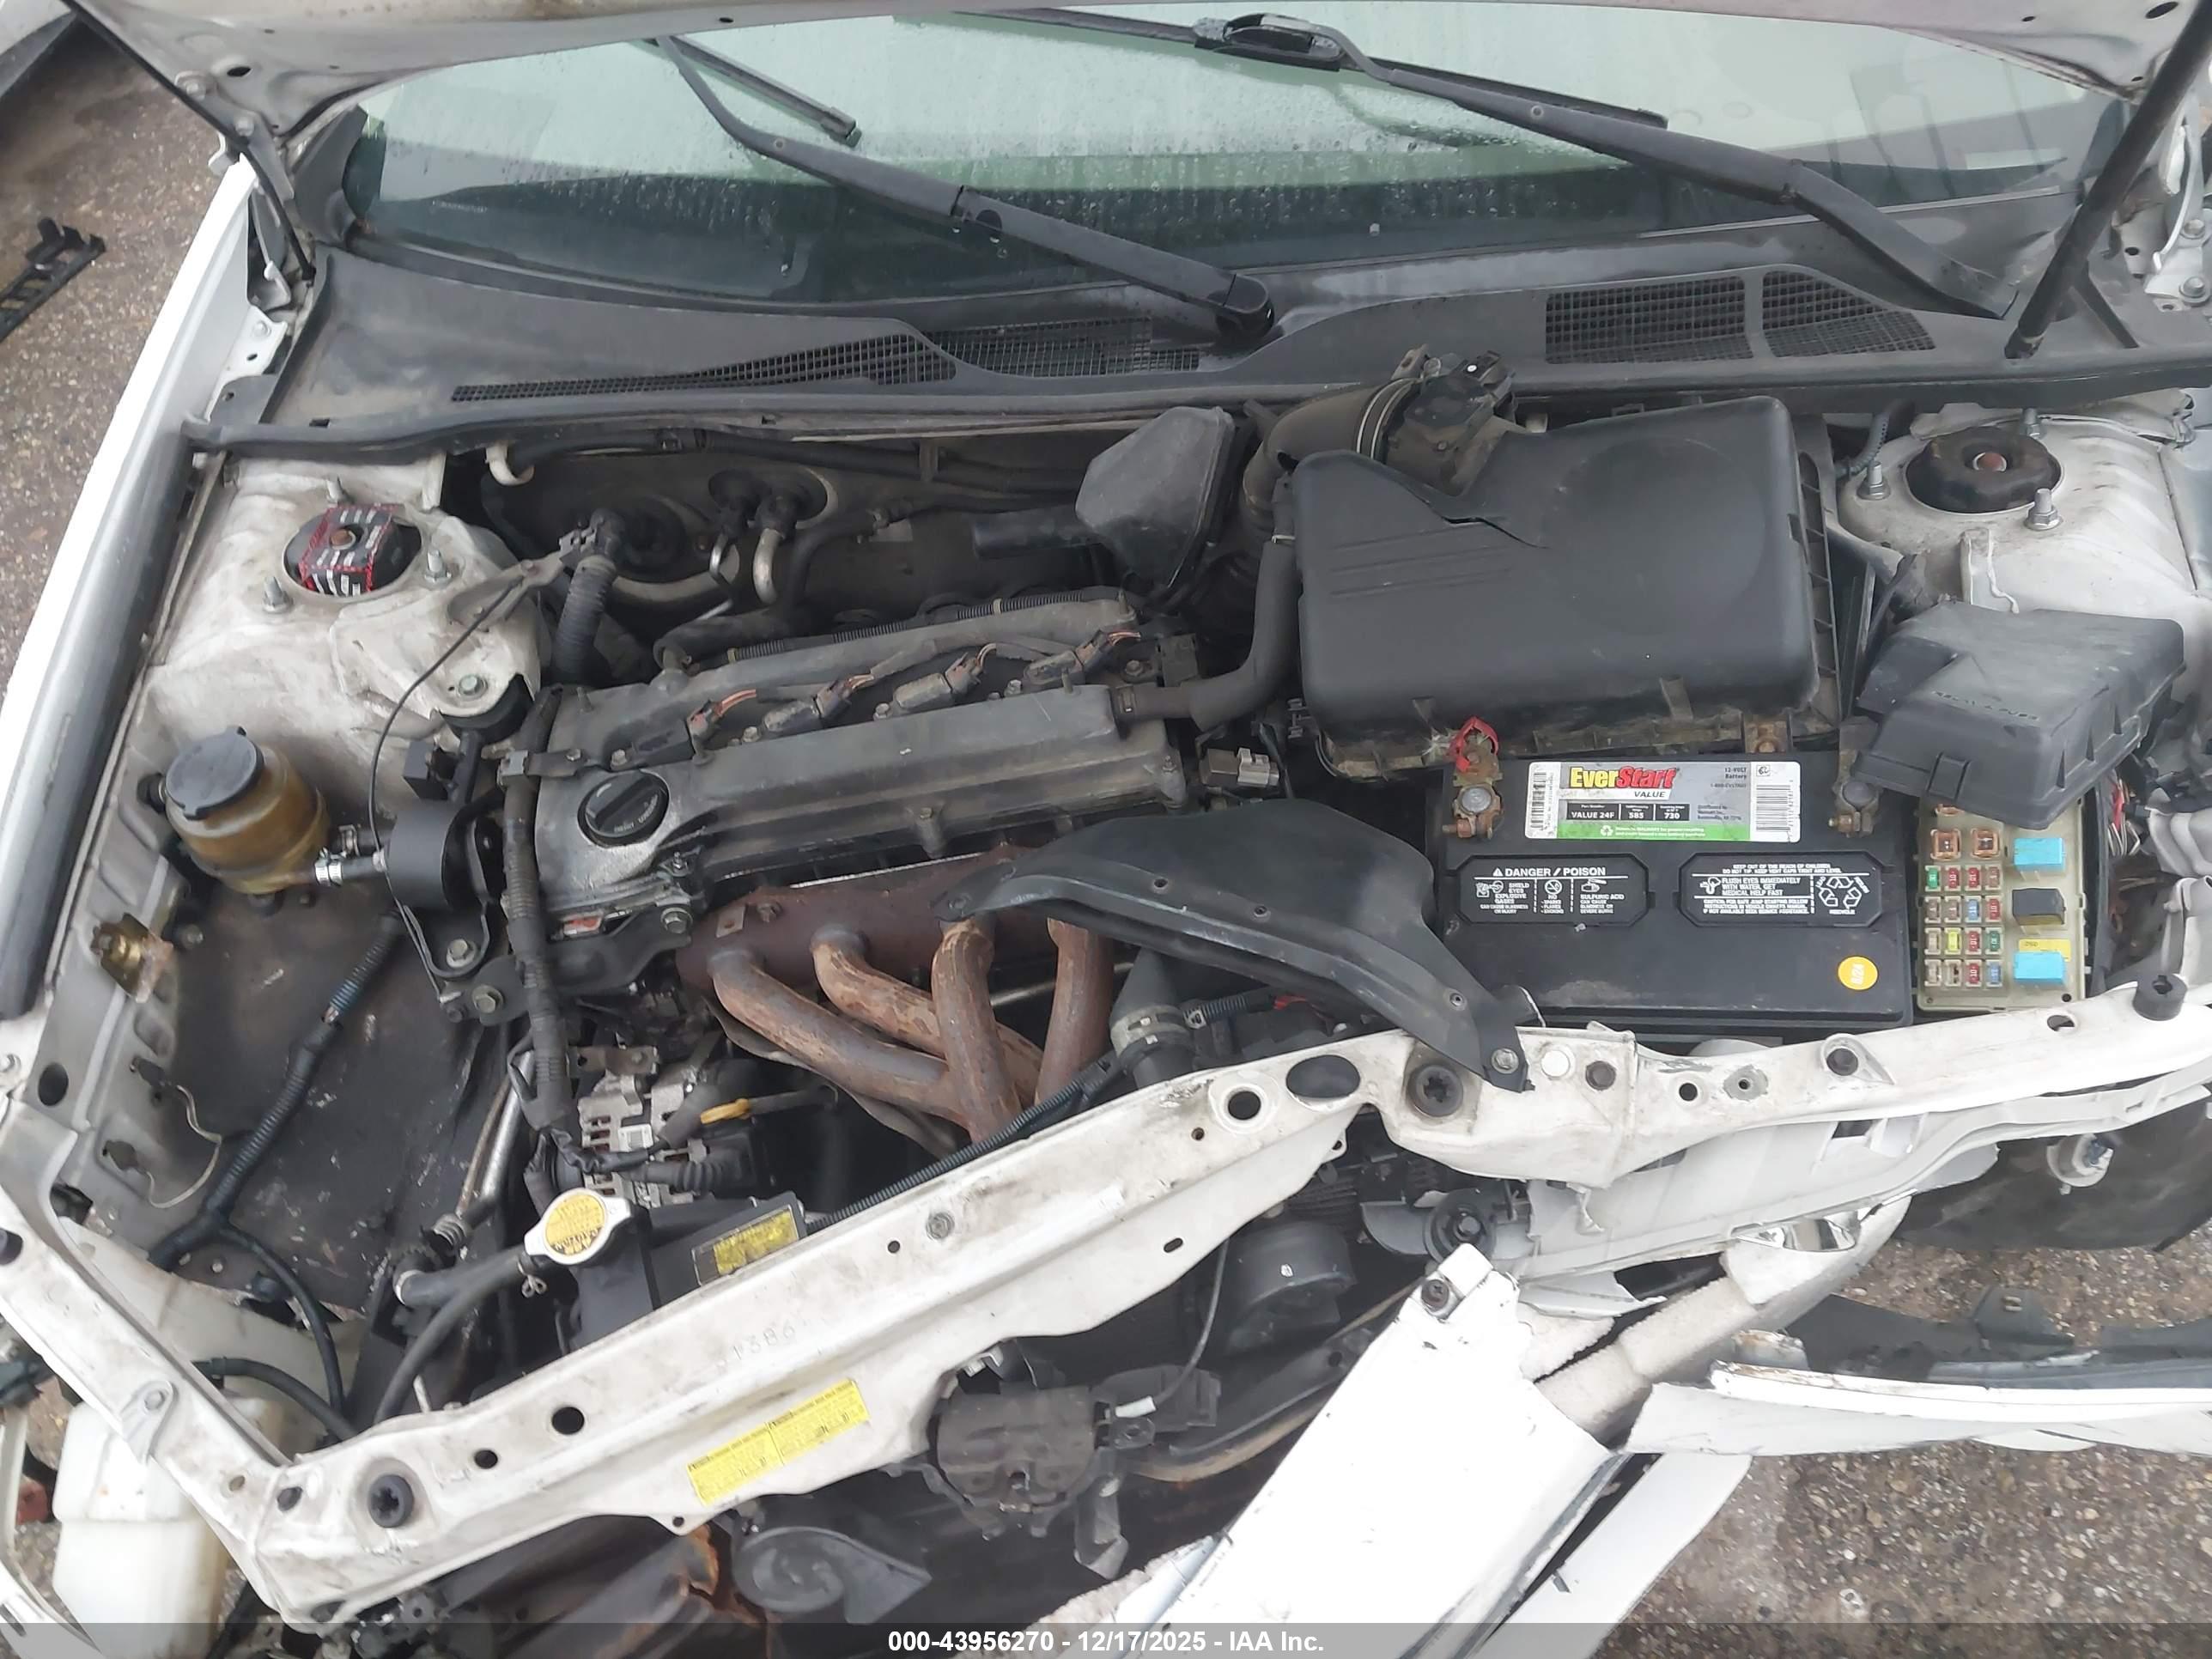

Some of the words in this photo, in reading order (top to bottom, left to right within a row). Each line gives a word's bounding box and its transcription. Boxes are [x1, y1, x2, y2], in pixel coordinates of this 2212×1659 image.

[1569, 765, 1677, 789] EverStart
[1504, 867, 1551, 877] DANGER
[1563, 866, 1607, 876] POISON
